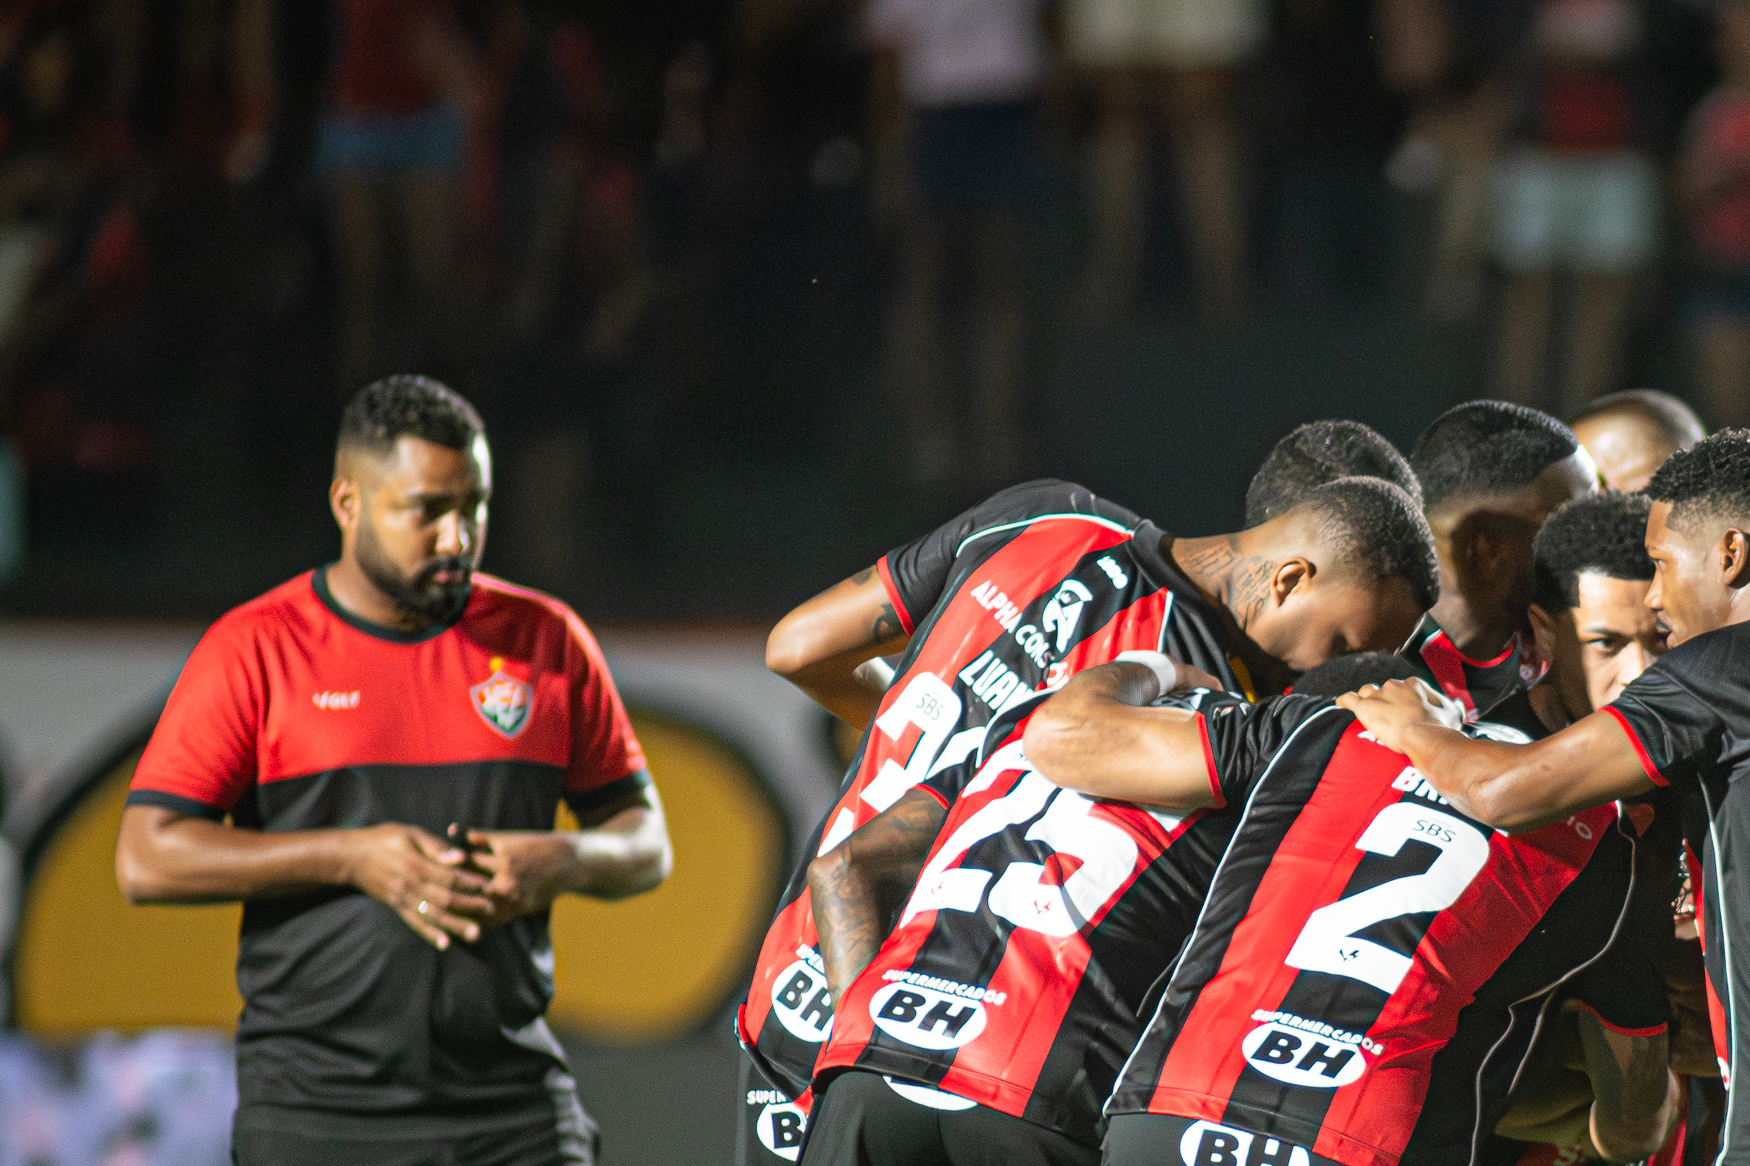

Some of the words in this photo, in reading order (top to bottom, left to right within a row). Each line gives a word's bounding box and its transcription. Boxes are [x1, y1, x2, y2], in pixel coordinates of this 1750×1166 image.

[970, 580, 1021, 633] ALPHA
[916, 693, 944, 721] SBS
[1412, 820, 1456, 842] SBS
[1284, 802, 1490, 995] 2
[776, 969, 834, 1031] BH
[881, 969, 1008, 1006] SUPERMERCADOS
[877, 989, 977, 1039] BH
[1251, 1009, 1384, 1056] SUPERMERCADOS
[1251, 1030, 1356, 1079] BH
